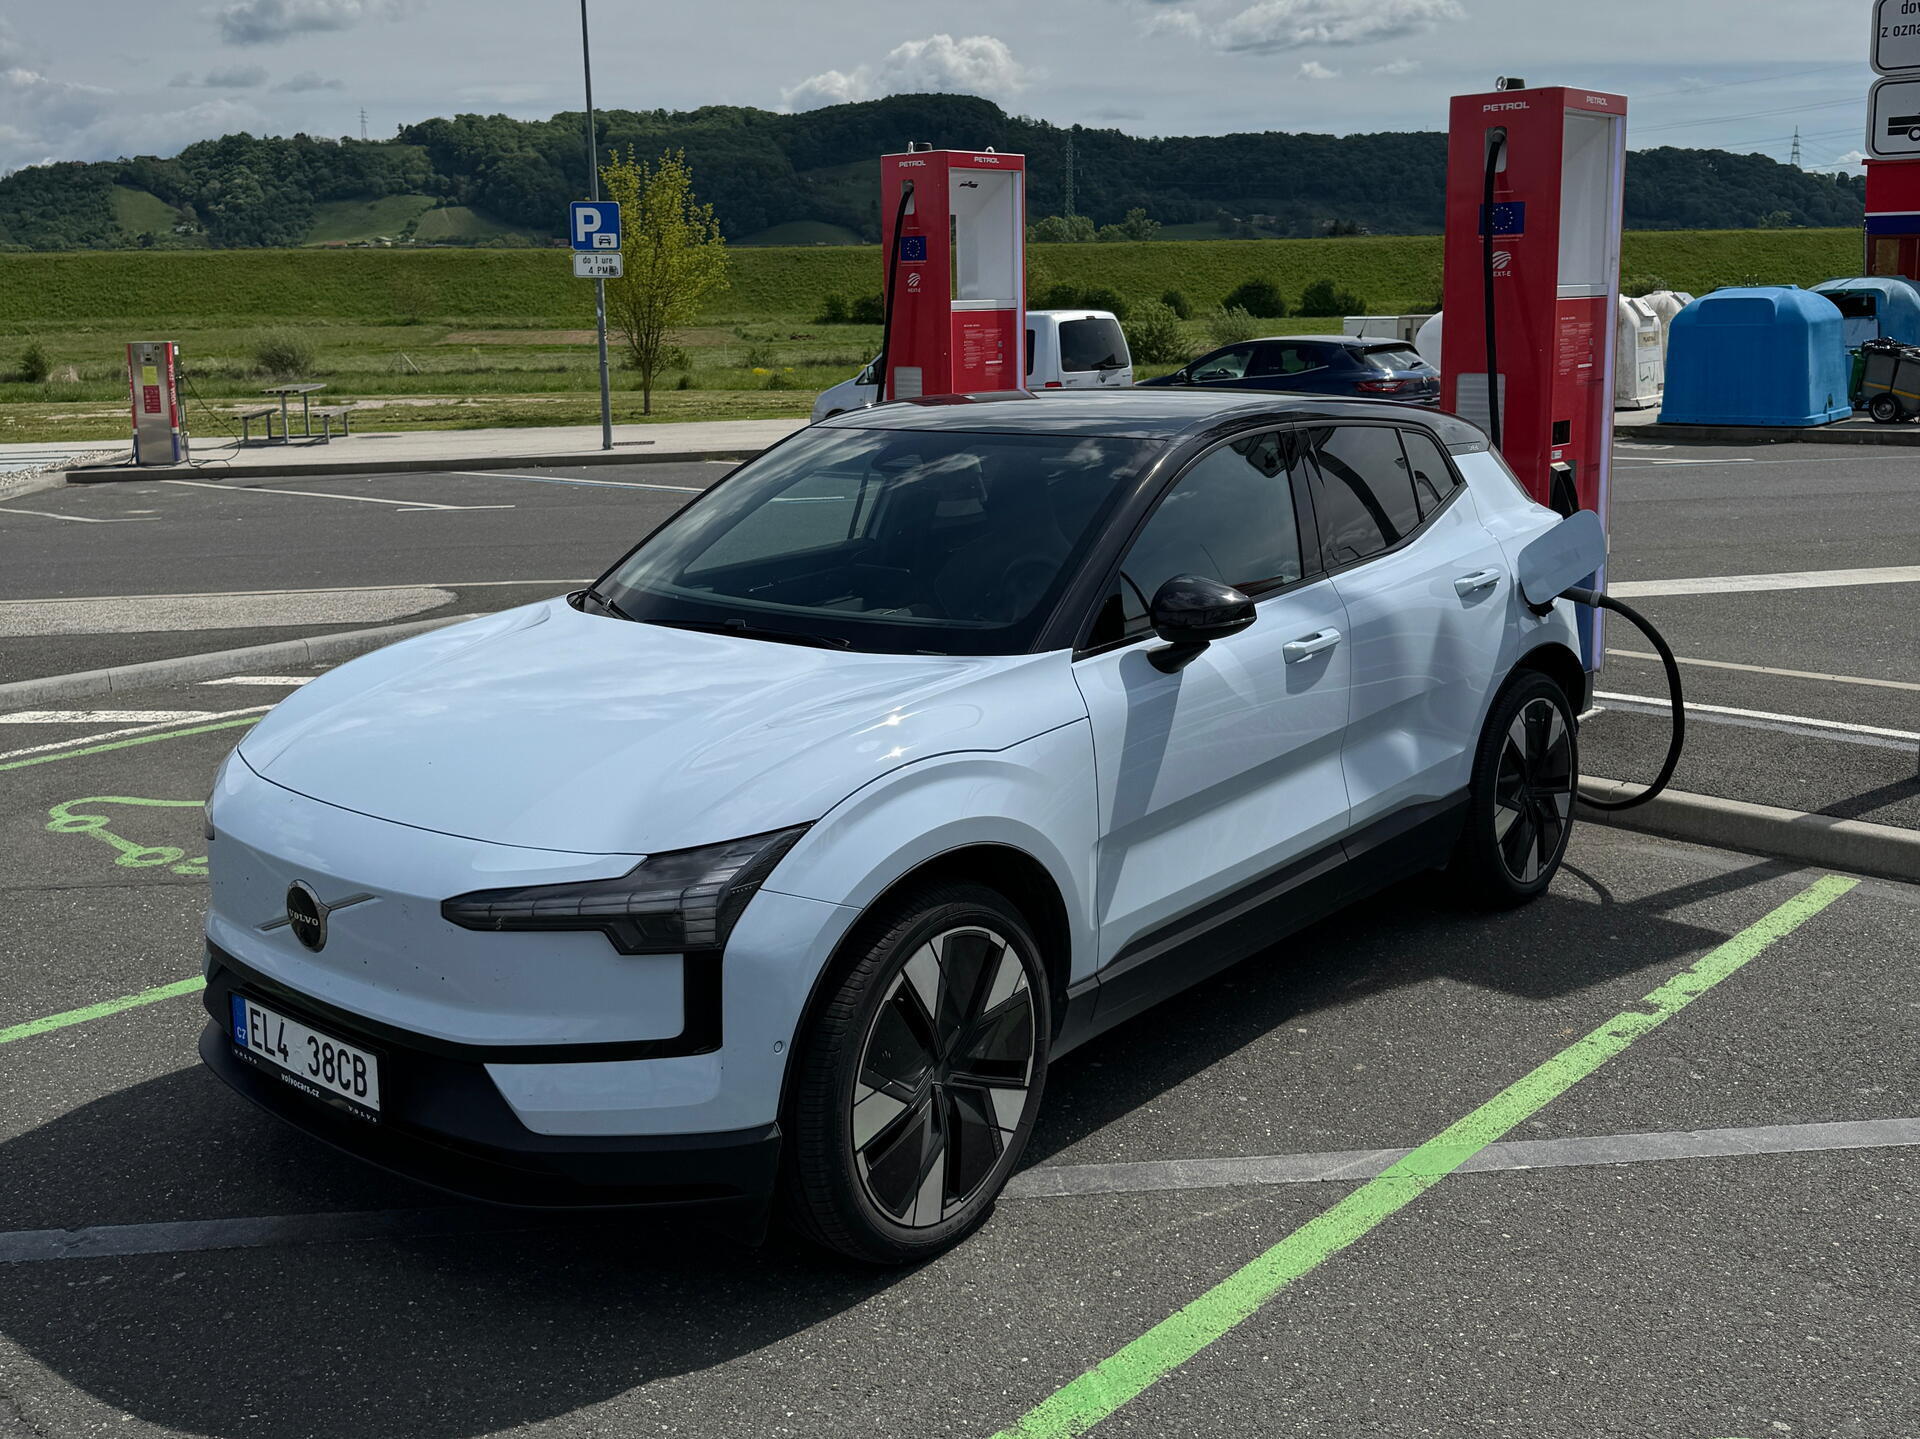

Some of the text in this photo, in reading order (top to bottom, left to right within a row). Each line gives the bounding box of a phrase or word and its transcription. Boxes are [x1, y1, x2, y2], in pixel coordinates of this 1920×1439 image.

[1881, 26, 1889, 38] z
[1482, 101, 1530, 113] PETROL
[1586, 95, 1608, 106] PETROL
[898, 160, 927, 168] PETROL
[974, 156, 1000, 164] PETROL
[575, 207, 602, 242] P
[582, 256, 613, 265] do 1 ure
[588, 266, 594, 275] 4
[288, 908, 319, 926] VOLVO
[236, 1026, 247, 1040] CZ
[234, 1049, 258, 1065] VOLVO
[249, 1006, 368, 1098] EL4 38CB
[281, 1072, 320, 1098] volvocars.cz
[348, 1105, 378, 1123] VOLVO
